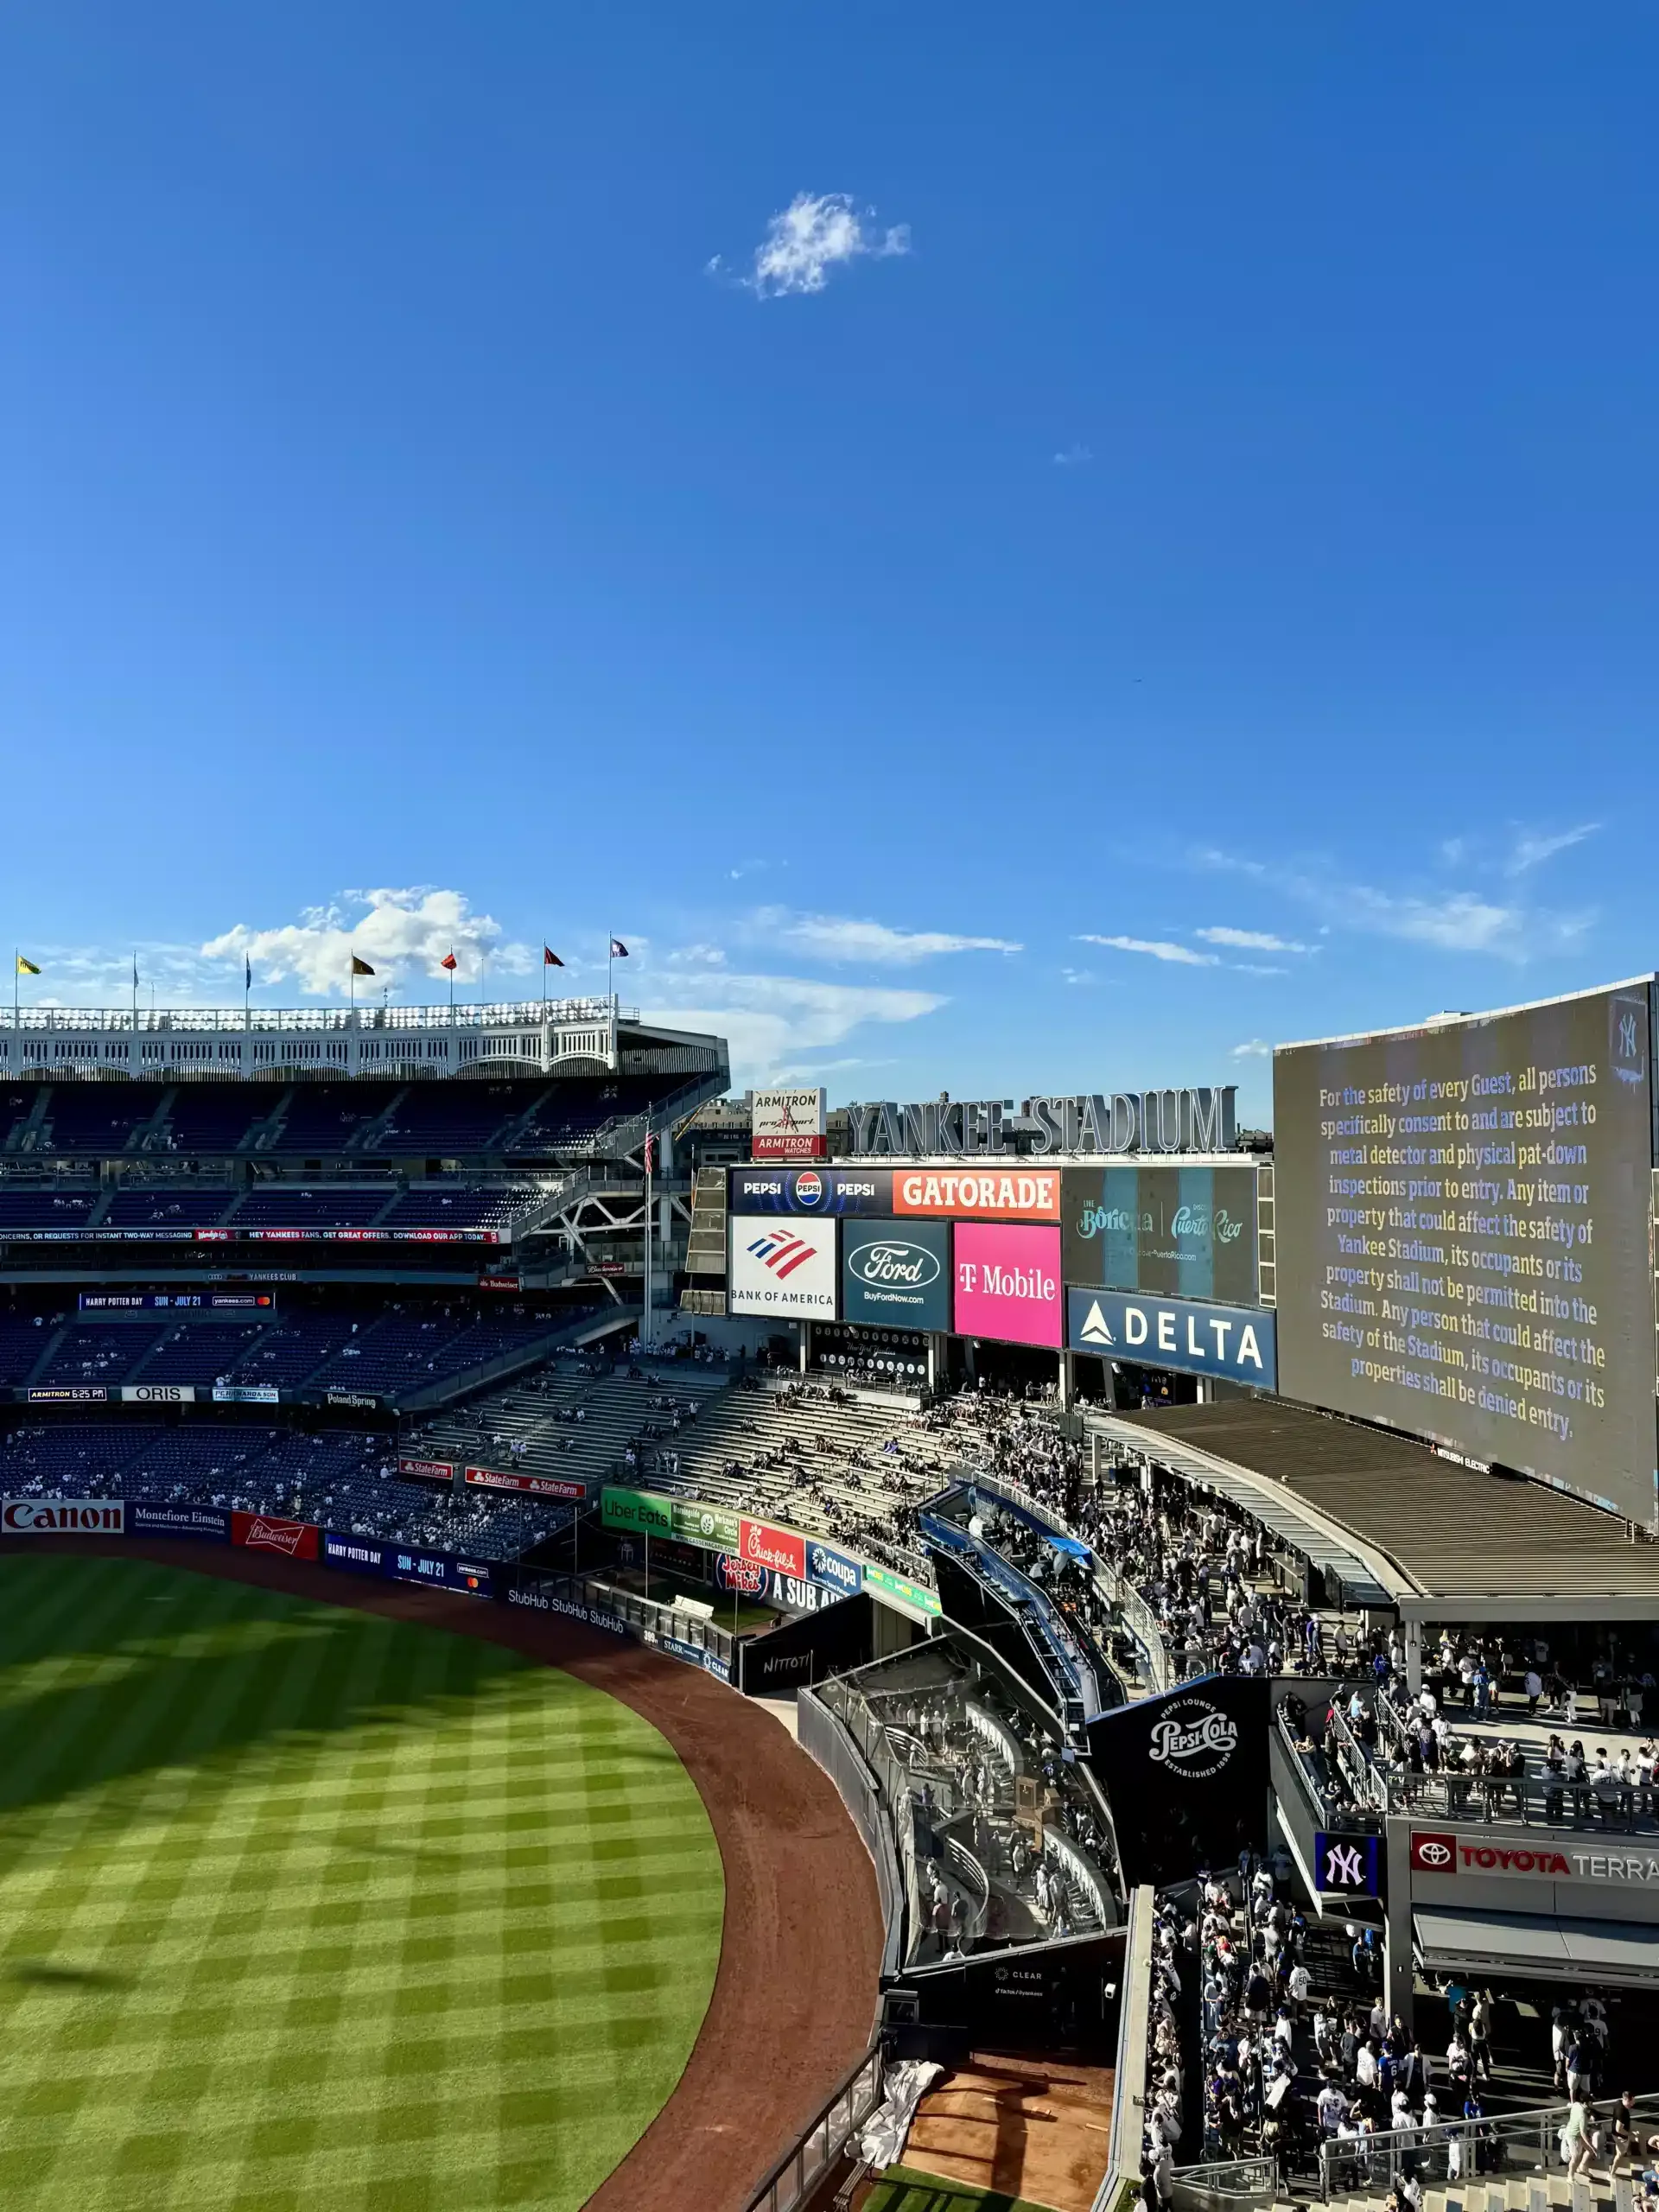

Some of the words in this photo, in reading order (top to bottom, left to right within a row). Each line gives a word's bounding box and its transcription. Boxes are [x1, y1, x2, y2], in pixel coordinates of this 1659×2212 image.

[1320, 1088, 1340, 1108] For
[1343, 1087, 1365, 1105] the
[1368, 1083, 1409, 1107] safety
[1413, 1079, 1426, 1101] of
[1429, 1079, 1468, 1103] every
[1471, 1072, 1516, 1096] Guest,
[1519, 1067, 1535, 1090] all
[1539, 1064, 1596, 1095] persons
[756, 1096, 816, 1107] ARMITRON
[846, 1100, 1013, 1155] YANKEE
[1031, 1086, 1238, 1155] STADIUM
[1320, 1114, 1395, 1140] specifically
[1399, 1114, 1452, 1134] consent
[1455, 1111, 1468, 1132] to
[1471, 1107, 1497, 1131] and
[1500, 1109, 1523, 1129] are
[1525, 1103, 1578, 1133] subject
[1581, 1103, 1596, 1124] to
[759, 1138, 813, 1147] ARMITRON
[1330, 1145, 1367, 1165] metal
[1370, 1145, 1426, 1165] detector
[1429, 1143, 1454, 1166] and
[1458, 1141, 1516, 1170] physical
[1519, 1141, 1586, 1166] pat-down
[744, 1182, 781, 1194] PEPSI
[837, 1184, 874, 1196] PEPSI
[903, 1176, 1054, 1209] GATORADE
[1329, 1175, 1406, 1198] inspections
[1408, 1179, 1442, 1203] prior
[1445, 1179, 1459, 1198] to
[1461, 1179, 1503, 1206] entry.
[1506, 1179, 1535, 1206] Any
[1537, 1179, 1571, 1204] item
[1573, 1183, 1589, 1205] or
[863, 1246, 925, 1282] Ford
[1338, 1235, 1385, 1257] Yankee
[1389, 1238, 1448, 1267] Stadium,
[1451, 1243, 1468, 1266] its
[1472, 1251, 1543, 1278] occupants
[1547, 1259, 1560, 1279] or
[1563, 1257, 1582, 1283] its
[490, 1281, 518, 1289] Budweiser
[982, 1265, 1056, 1301] Mobile
[86, 1298, 106, 1306] HARRY
[108, 1298, 130, 1306] POTTER
[131, 1297, 143, 1306] DAY
[155, 1296, 168, 1306] SUN
[175, 1296, 192, 1306] JULY
[193, 1296, 200, 1306] 21
[731, 1290, 760, 1300] BANK
[765, 1292, 779, 1301] OF
[782, 1293, 833, 1305] AMERICA
[863, 1292, 925, 1305] BuyFordNow.com
[1125, 1306, 1264, 1370] DELTA
[1320, 1290, 1378, 1317] Stadium.
[1382, 1299, 1408, 1326] Any
[1411, 1308, 1459, 1332] person
[1461, 1313, 1490, 1339] that
[1493, 1319, 1531, 1349] could
[1534, 1328, 1577, 1361] affect
[1580, 1338, 1605, 1368] the
[136, 1388, 181, 1401] ORIS
[327, 1393, 351, 1403] Poland
[352, 1395, 376, 1408] Spring
[1351, 1357, 1421, 1390] properties
[1423, 1372, 1456, 1401] shall
[1459, 1379, 1476, 1405] be
[1478, 1385, 1527, 1421] denied
[1529, 1398, 1573, 1440] entry.
[1465, 1458, 1490, 1474] ELECTRIC
[4, 1503, 121, 1529] Canon
[136, 1508, 189, 1522] Montefiore
[192, 1512, 224, 1526] Einstein
[606, 1499, 637, 1520] Uber
[638, 1507, 668, 1527] Eats
[253, 1524, 297, 1546] Budweiser
[327, 1542, 346, 1557] HARRY
[347, 1546, 369, 1562] POTTER
[370, 1551, 381, 1565] DAY
[748, 1533, 797, 1571] Chick-fil-A
[397, 1554, 411, 1571] SUN
[417, 1559, 434, 1575] JULY
[435, 1562, 444, 1577] 21
[722, 1554, 761, 1576] Jersey
[827, 1557, 856, 1586] coupa
[773, 1573, 783, 1600] A
[508, 1589, 549, 1610] StubHub
[551, 1599, 588, 1621] StubHub
[590, 1610, 624, 1635] StubHub
[644, 1630, 655, 1642] 399
[664, 1641, 683, 1654] STARR
[711, 1662, 728, 1678] CLEAR
[1160, 1700, 1181, 1719] PEPSI
[1183, 1699, 1217, 1713] LOUNGE
[1165, 1759, 1217, 1778] ESTABLISHED
[1217, 1752, 1231, 1770] 1898
[1459, 1845, 1571, 1875] TOYOTA
[1299, 1976, 1306, 1986] 50
[1391, 2065, 1397, 2076] 6
